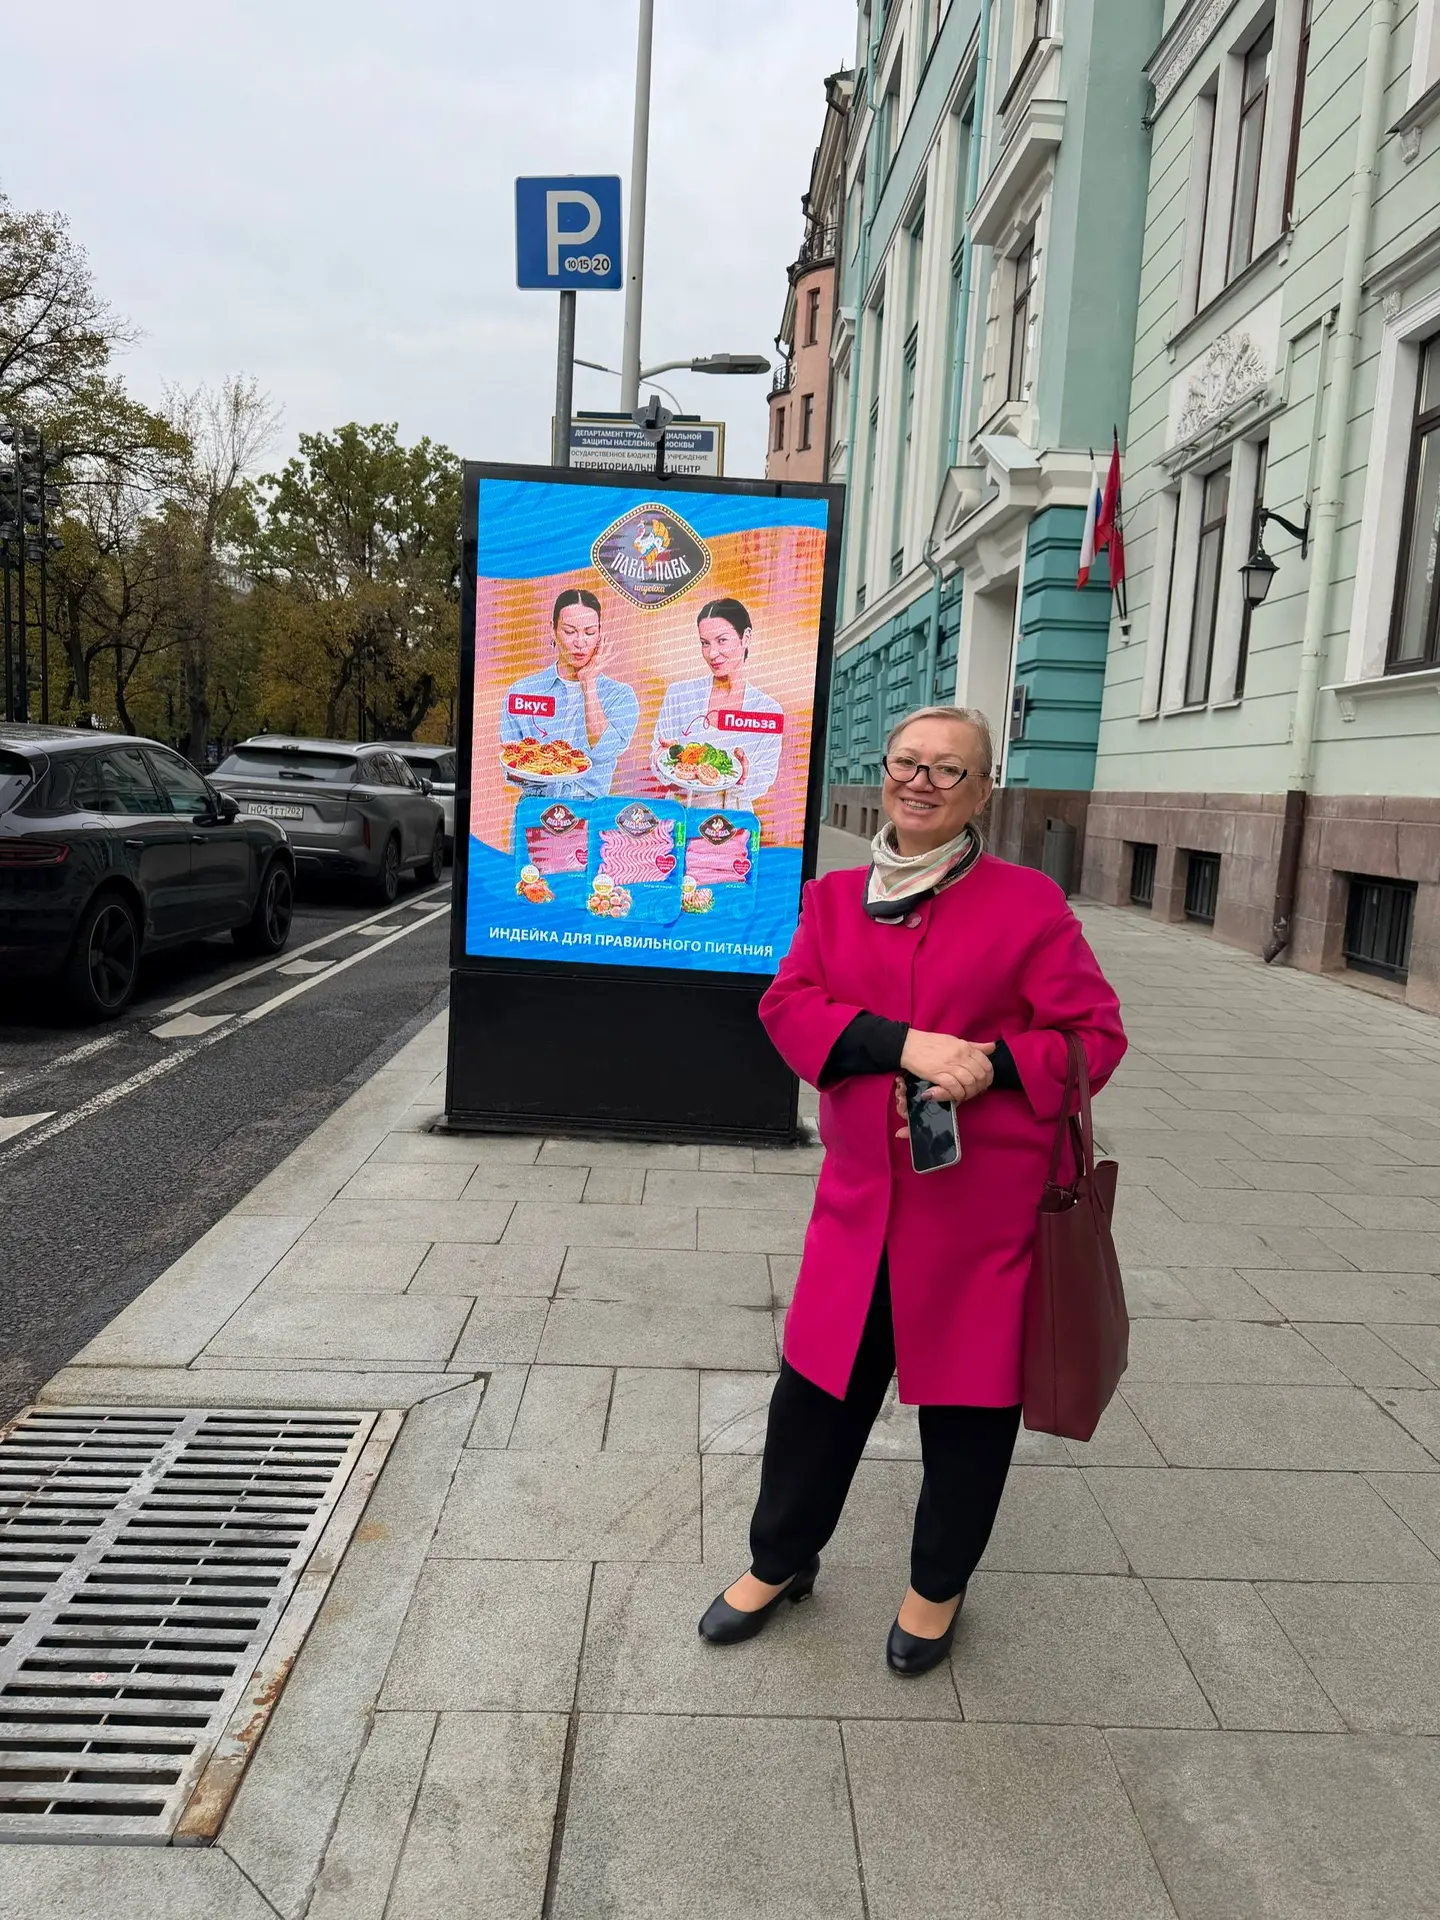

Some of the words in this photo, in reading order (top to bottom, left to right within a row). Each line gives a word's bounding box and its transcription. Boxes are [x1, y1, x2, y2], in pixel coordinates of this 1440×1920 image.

[546, 190, 601, 275] P
[567, 260, 577, 269] 10
[580, 259, 590, 270] 15
[593, 258, 610, 271] 20
[575, 429, 624, 438] ДЕПАРТАМЕНТ
[582, 438, 613, 446] ЗАЩИТЫ
[571, 450, 626, 459] ОСУДАРСТВЕННОЕ
[627, 452, 656, 460] БЮДЖЕТН
[667, 453, 708, 461] УЧРЕЖДЕНИЕ
[671, 464, 701, 474] ЦЕНТР
[611, 552, 645, 581] ПАВА
[655, 557, 691, 581] ПАВА
[515, 697, 548, 714] Вкус
[725, 714, 777, 729] Польза
[489, 927, 559, 943] ИНДЕЙКА
[561, 932, 591, 946] ДЛЯ
[595, 934, 701, 952] ПРАВИЛЬНОГО
[705, 941, 773, 958] ПИТАНИЯ
